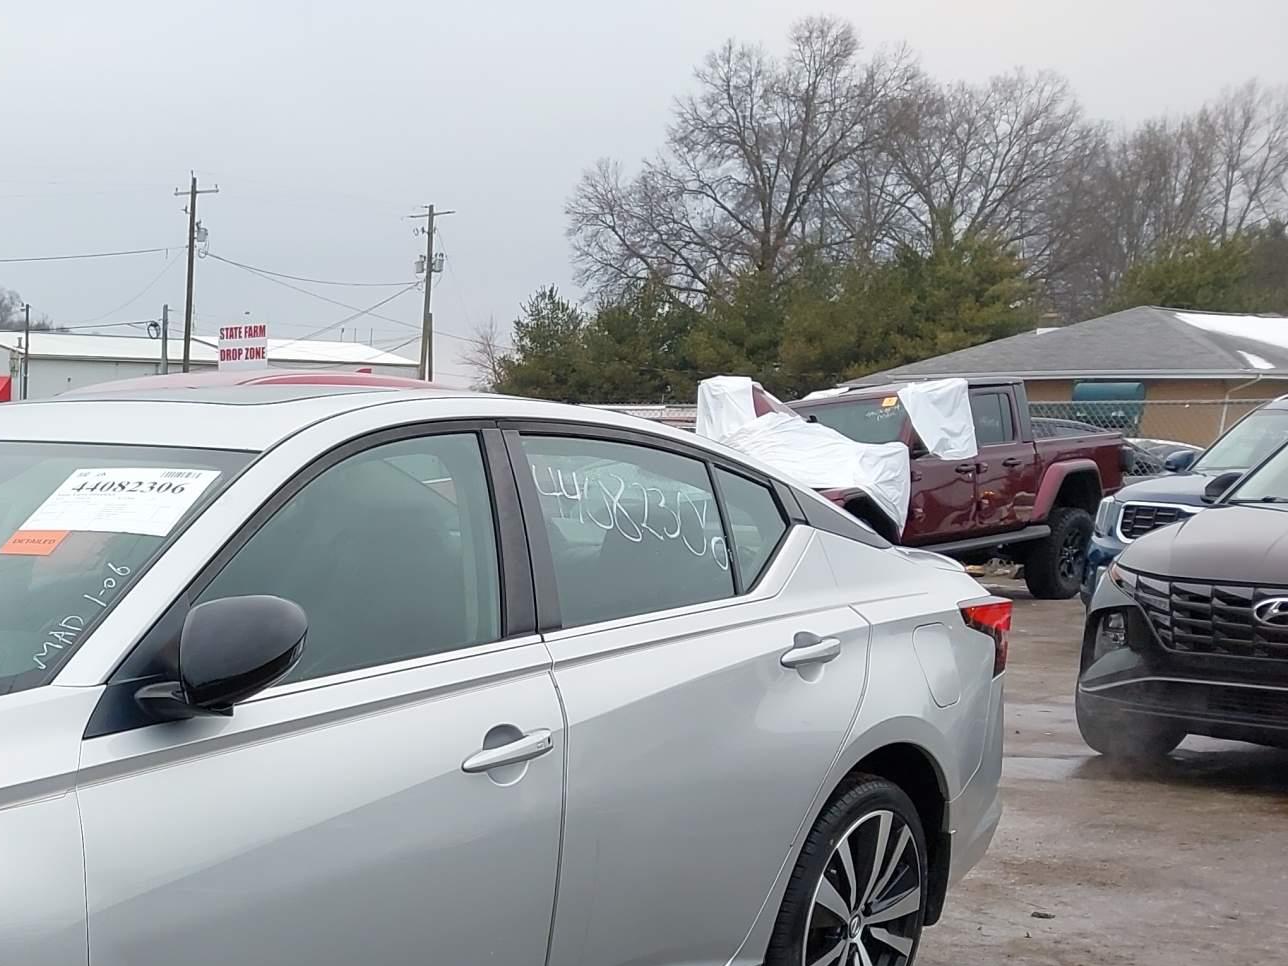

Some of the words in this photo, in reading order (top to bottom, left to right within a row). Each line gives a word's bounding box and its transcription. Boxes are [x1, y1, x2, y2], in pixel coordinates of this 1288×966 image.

[219, 326, 243, 340] STATE
[244, 324, 267, 339] FARM
[220, 347, 243, 362] DROP
[244, 346, 267, 361] ZONE
[71, 480, 187, 495] 44082306
[32, 614, 85, 671] MAD
[83, 561, 132, 608] 1-06
